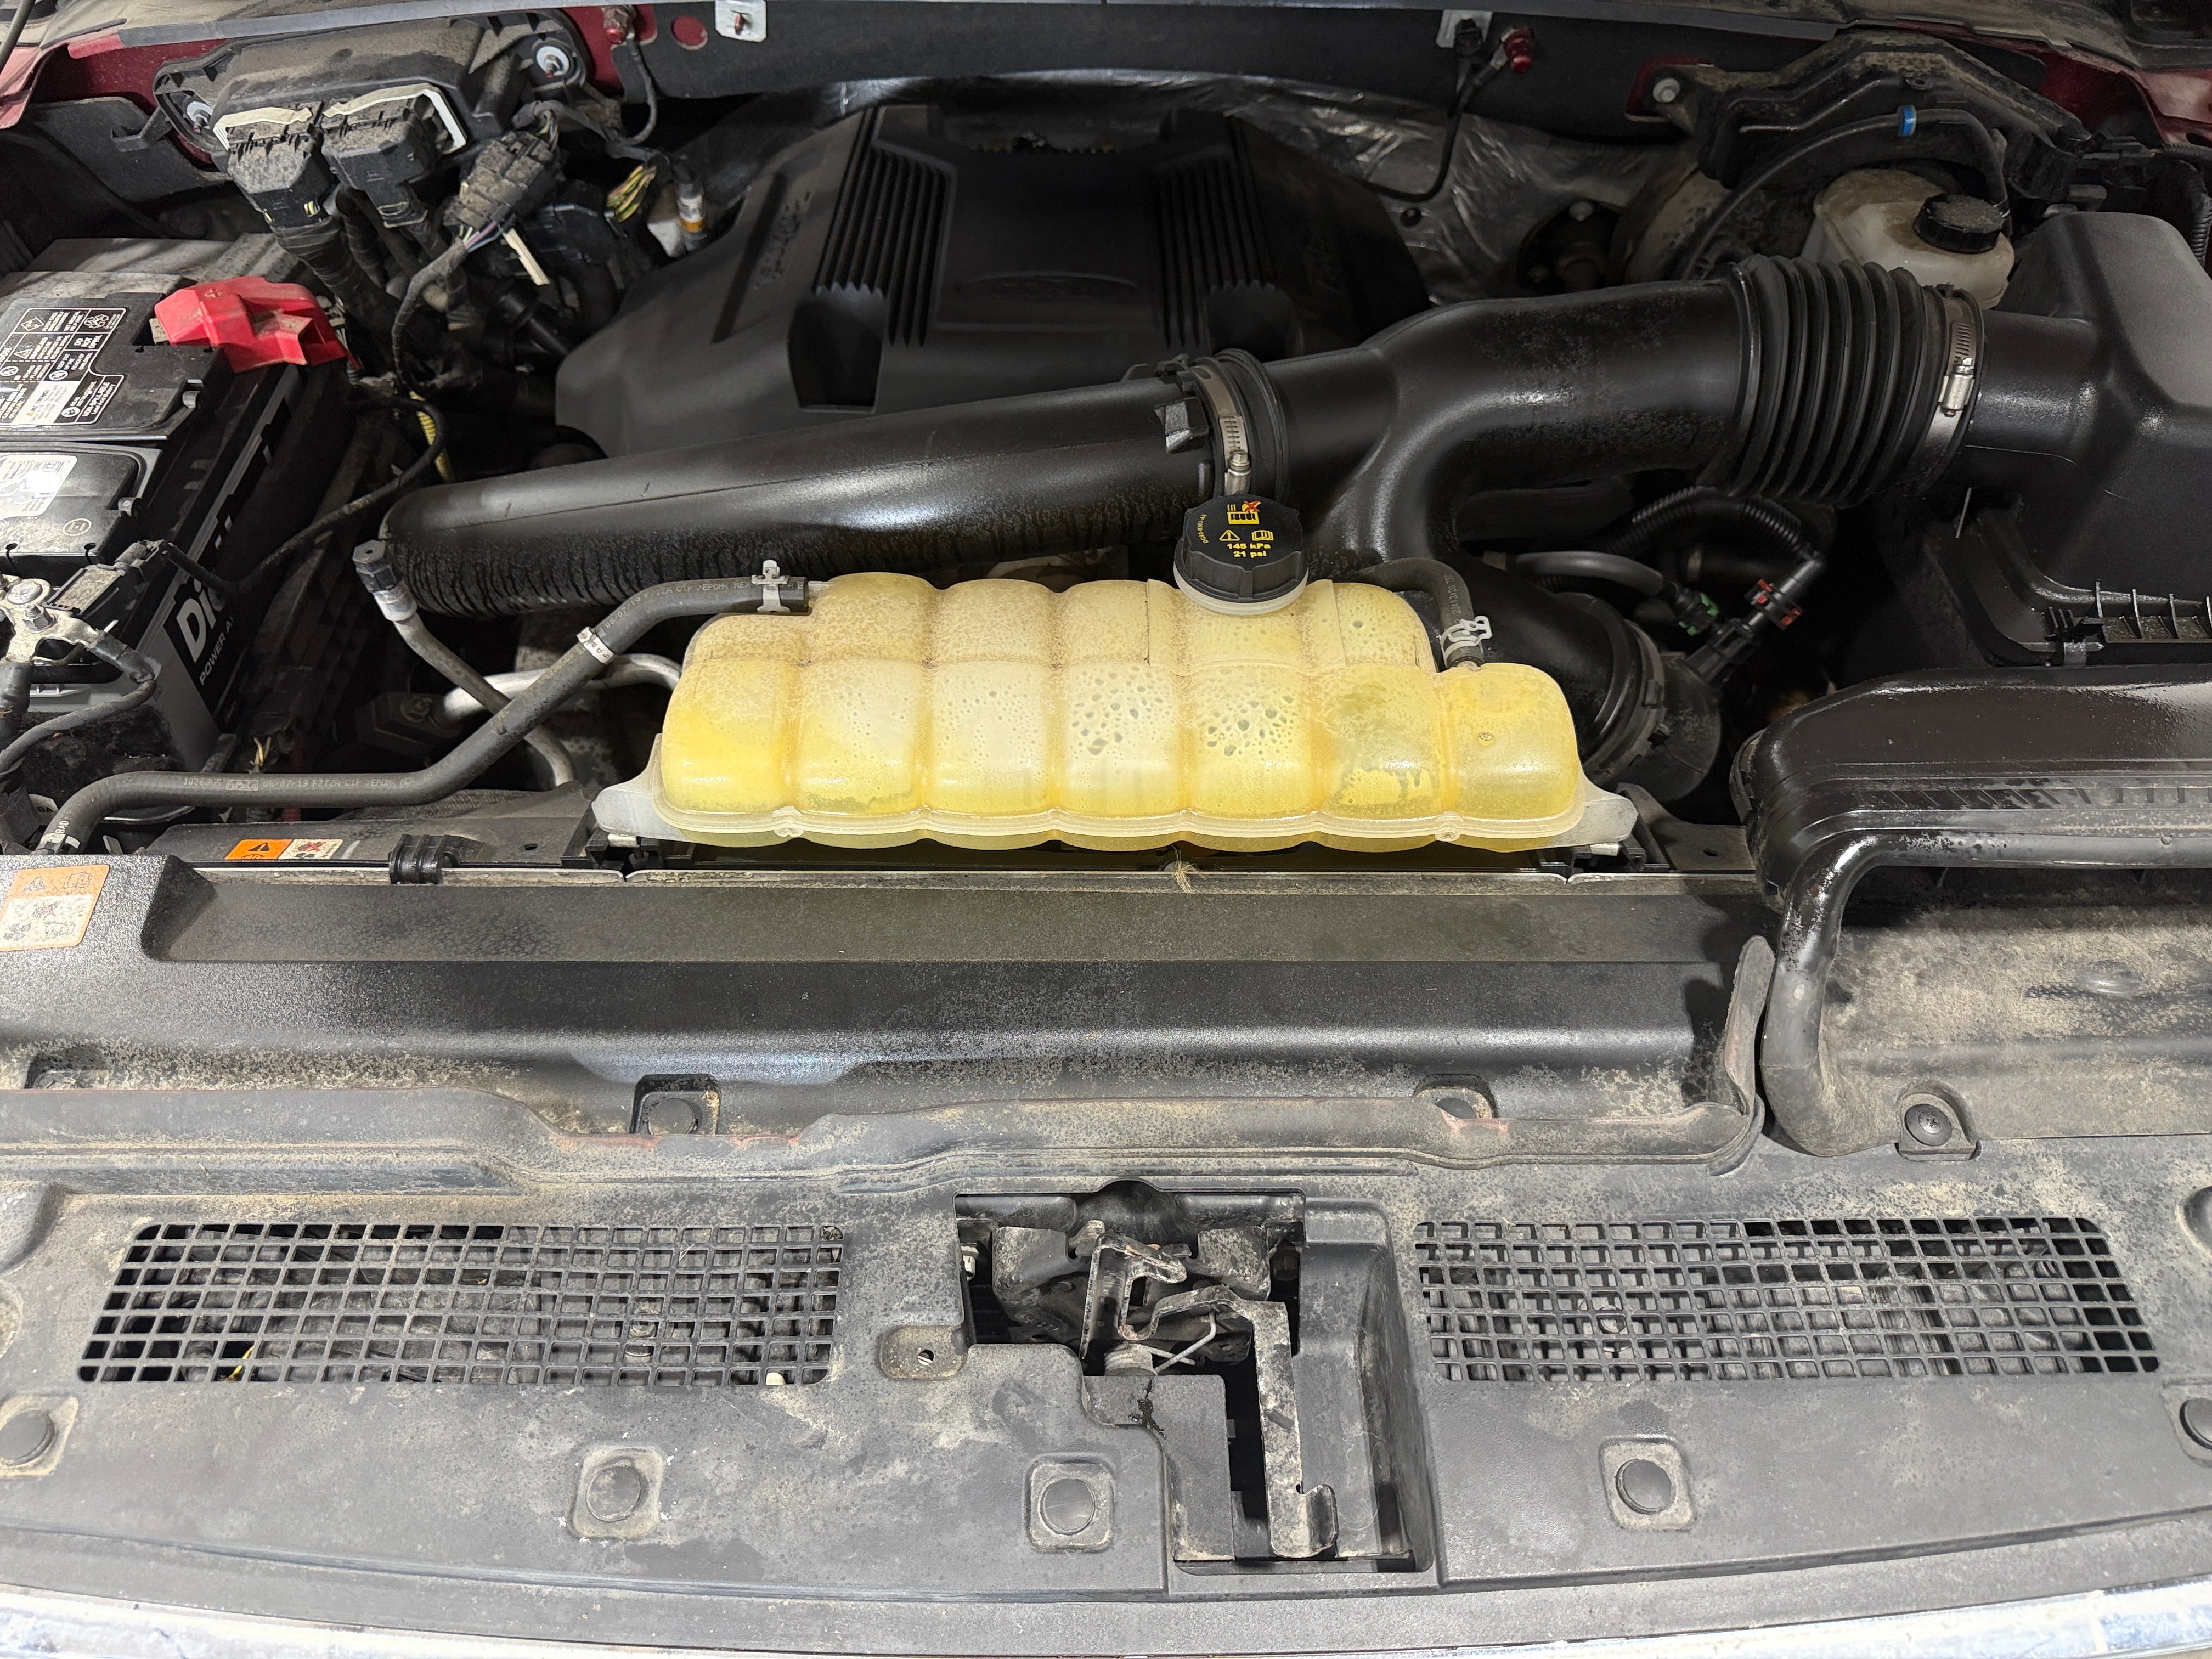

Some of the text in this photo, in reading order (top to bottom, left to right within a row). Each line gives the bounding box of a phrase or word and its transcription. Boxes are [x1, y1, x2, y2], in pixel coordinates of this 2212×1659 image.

[81, 337, 92, 347] NOT
[1250, 550, 1267, 558] psi
[199, 633, 227, 686] POWER
